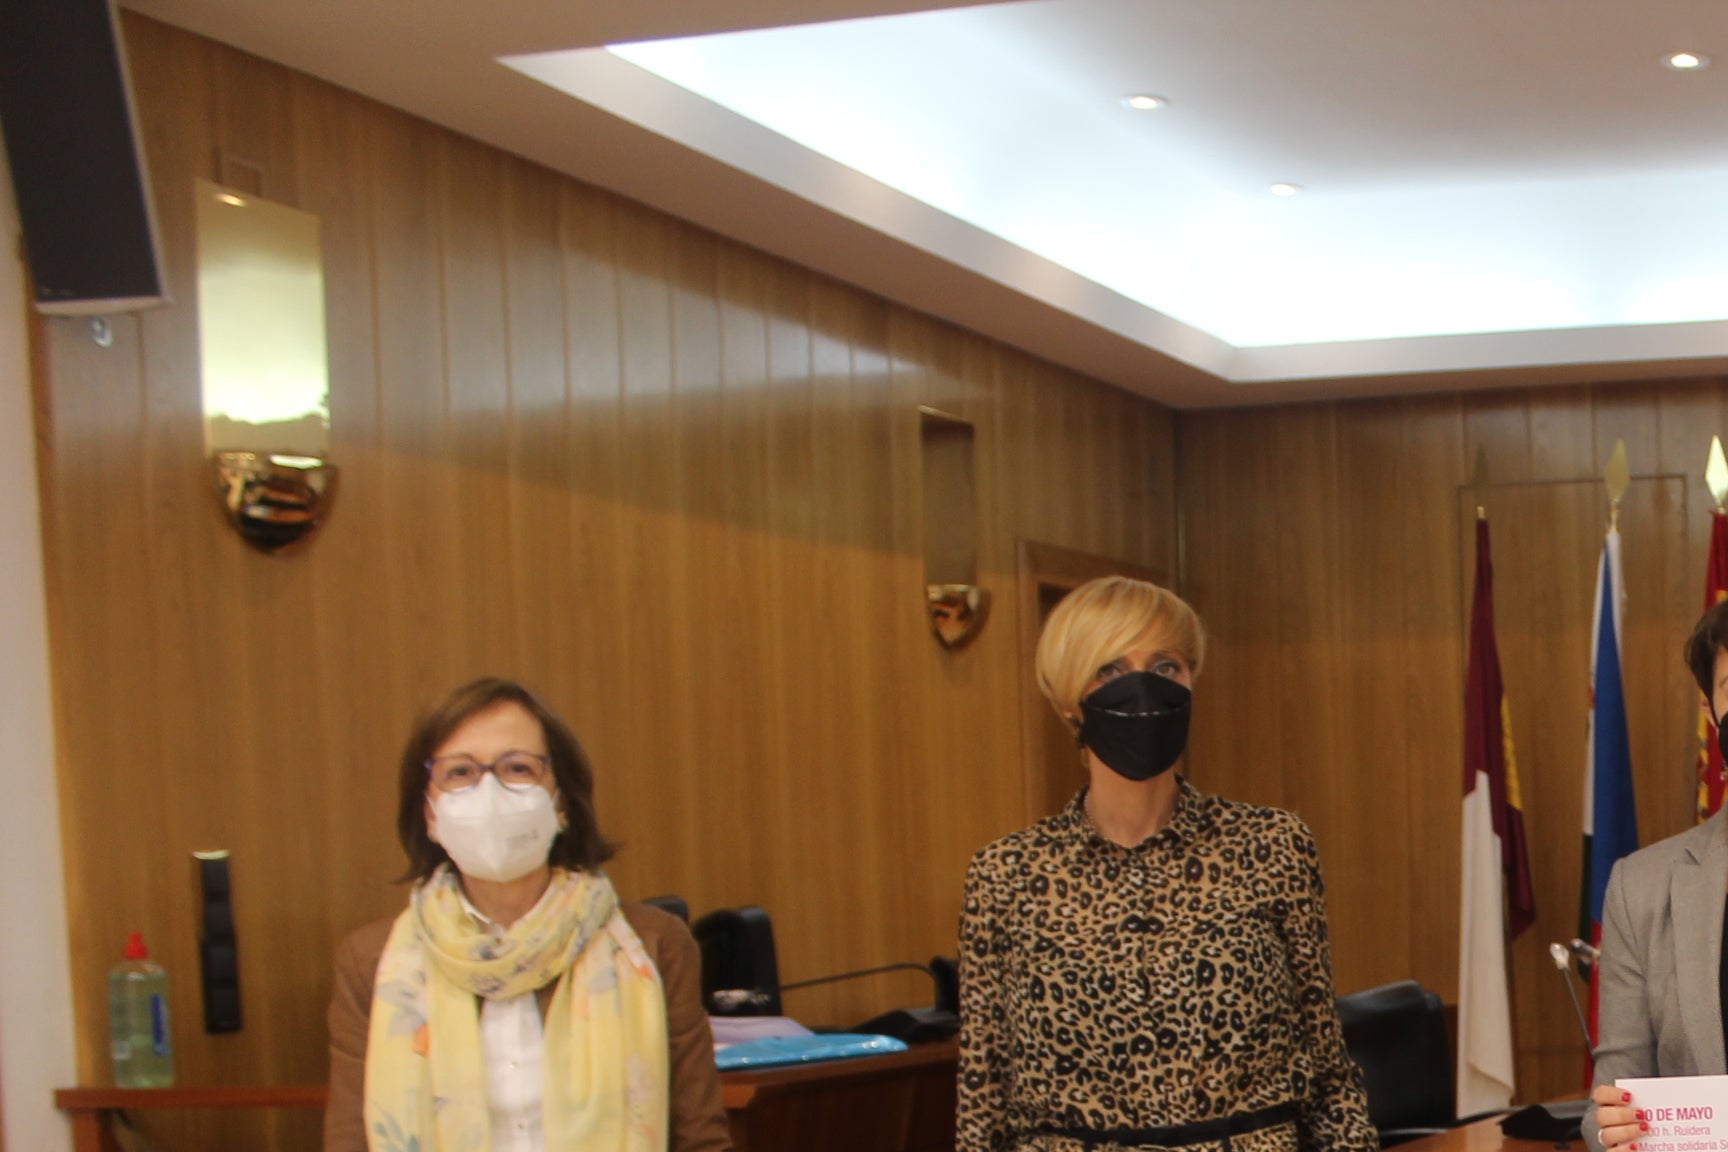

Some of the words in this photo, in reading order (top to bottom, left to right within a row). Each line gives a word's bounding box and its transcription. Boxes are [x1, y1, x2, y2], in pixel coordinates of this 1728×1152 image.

[1656, 1108, 1673, 1121] DE
[1676, 1107, 1713, 1120] MAYO
[1674, 1125, 1711, 1136] Ruidera
[1639, 1142, 1675, 1152] Marcha
[1677, 1140, 1718, 1152] solidaria
